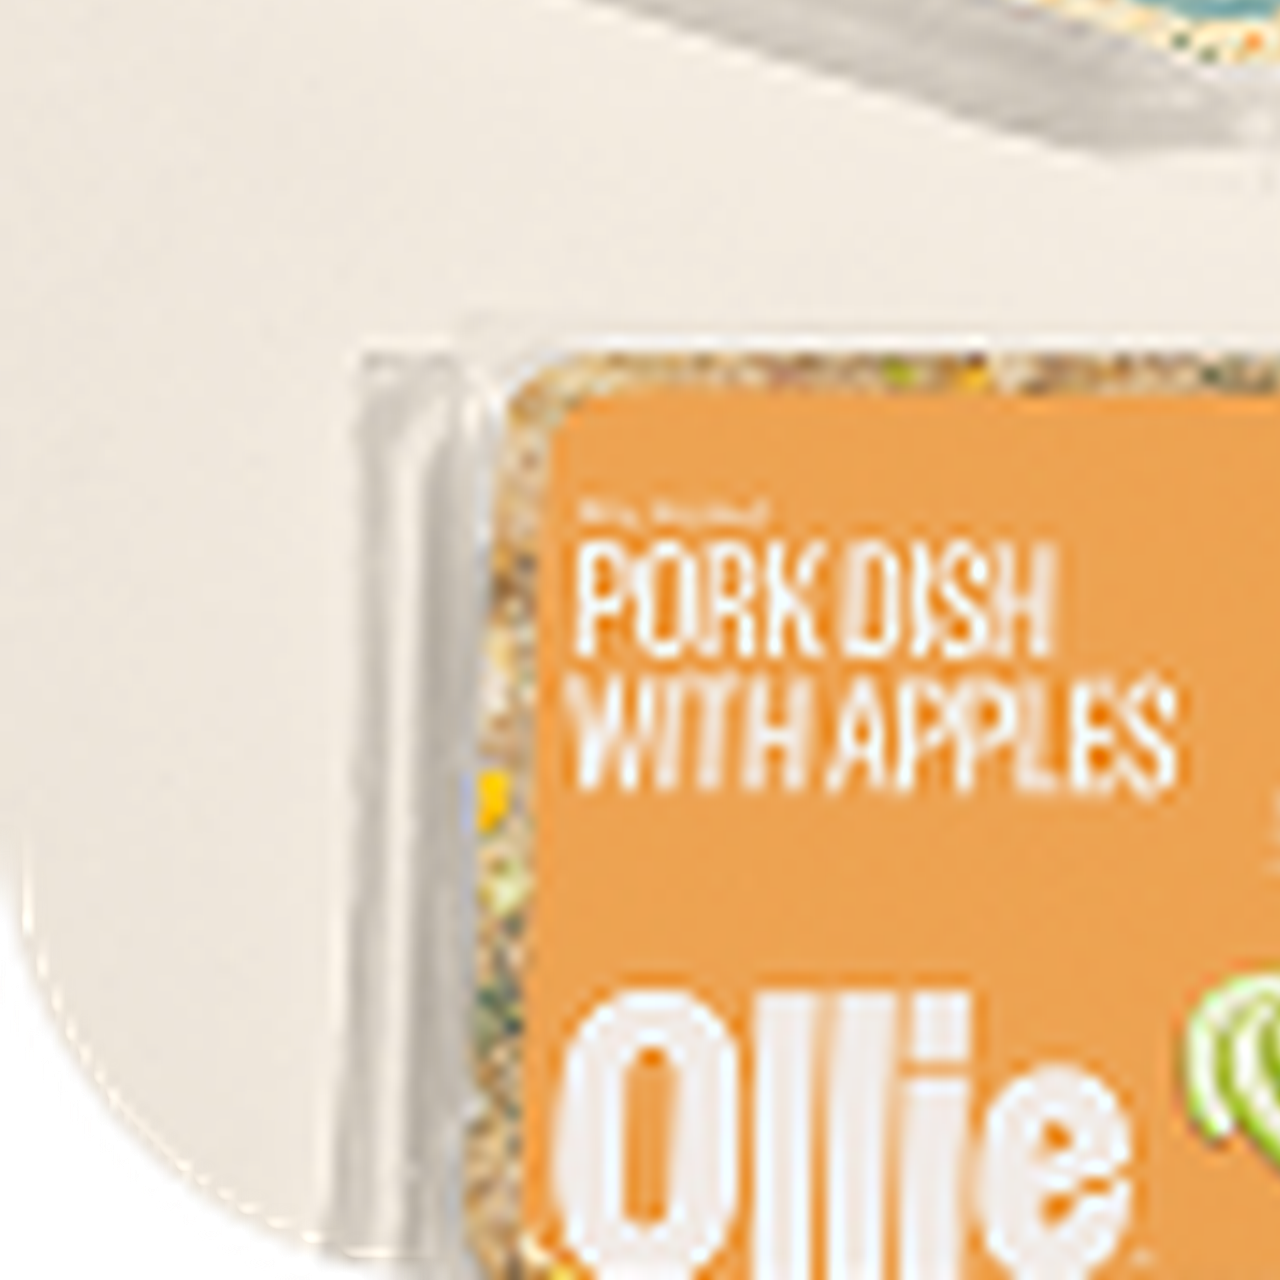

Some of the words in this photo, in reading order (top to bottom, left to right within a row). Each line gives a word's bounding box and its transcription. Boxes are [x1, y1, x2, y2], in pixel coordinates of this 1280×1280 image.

[574, 539, 827, 660] PORK
[841, 539, 1057, 660] DISH
[566, 673, 809, 795] WITH
[825, 675, 1178, 797] APPLES
[556, 987, 1131, 1280] Ollie
